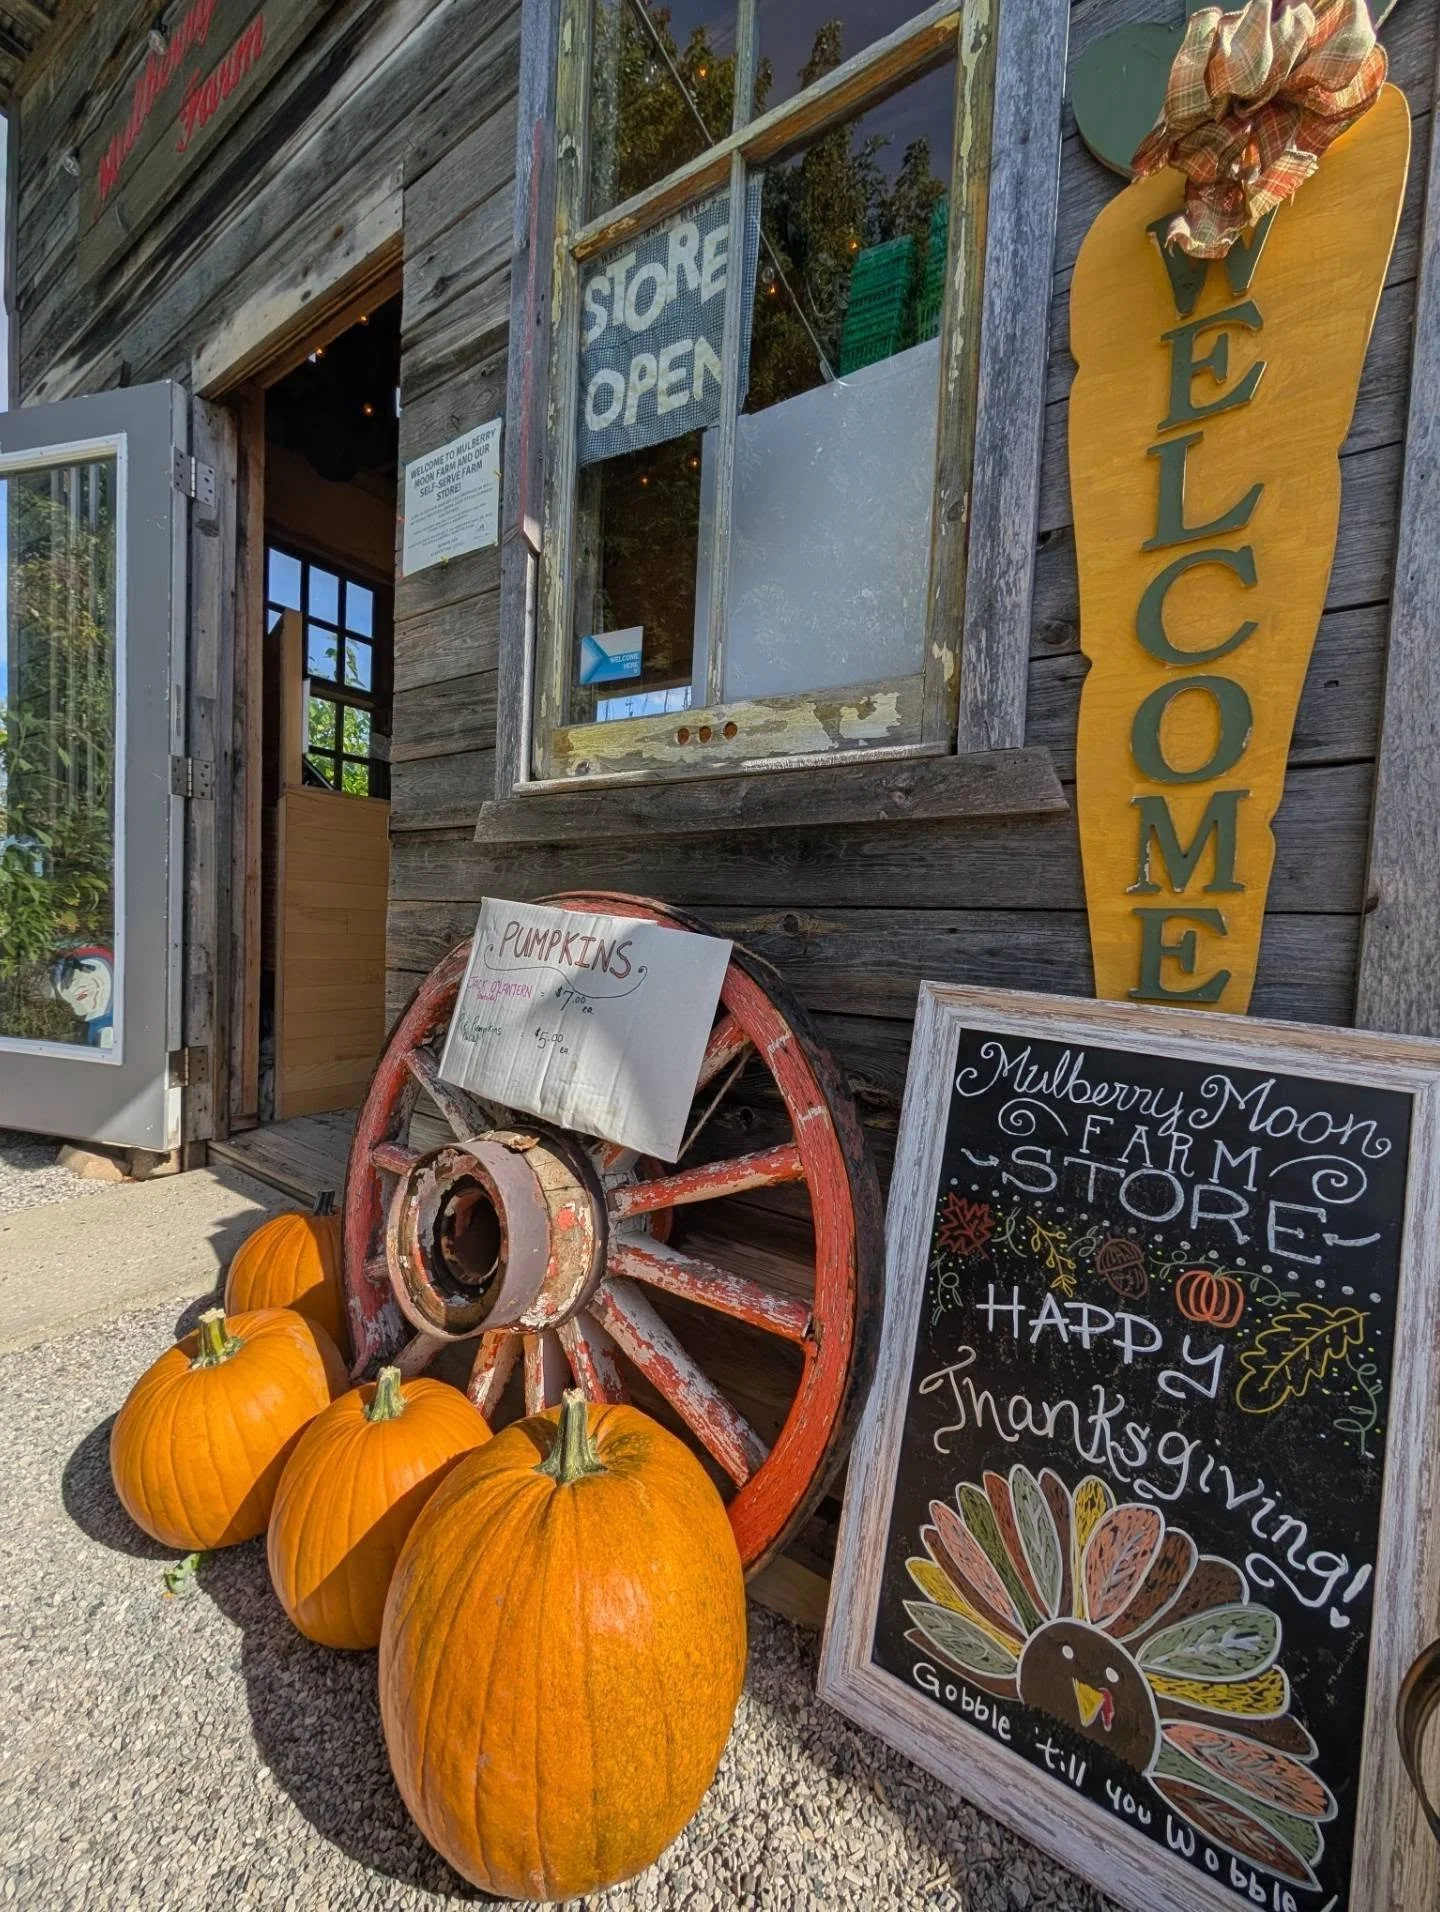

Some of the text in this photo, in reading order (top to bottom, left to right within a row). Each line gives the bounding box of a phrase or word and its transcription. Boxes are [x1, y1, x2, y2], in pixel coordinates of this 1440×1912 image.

[584, 222, 728, 348] STORE
[585, 336, 723, 431] OPEN
[410, 428, 496, 479] WELCOME TO MULBERRY
[414, 444, 490, 488] MOON FARM AND OUR
[420, 461, 483, 498] SELF-SERVE FARM
[1127, 204, 1279, 1005] WELCOME
[610, 653, 640, 663] WELCOME
[499, 920, 633, 979] PUMPKINS
[956, 1041, 1392, 1158] Mulberry Moon
[1079, 1114, 1262, 1192] FARM
[1002, 1146, 1328, 1265] STORE
[913, 1662, 1011, 1741] Gobble
[1106, 1779, 1151, 1824] you
